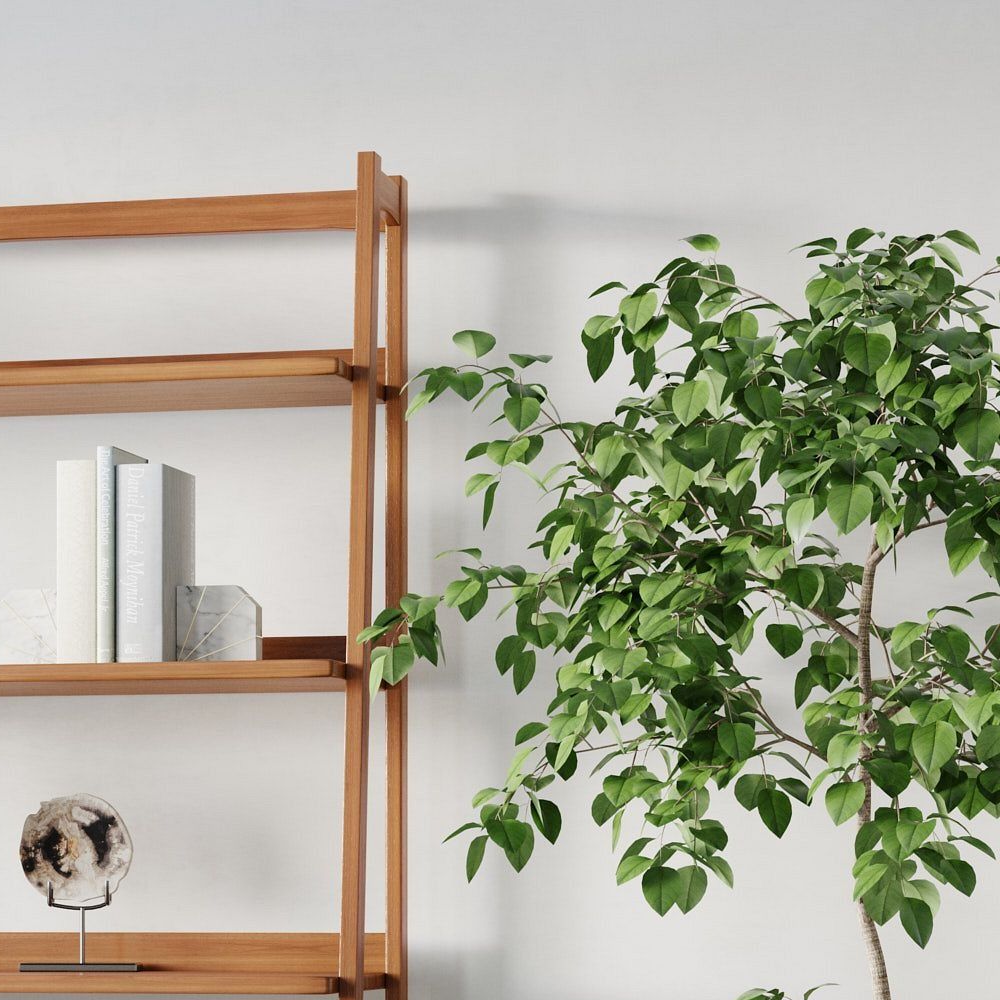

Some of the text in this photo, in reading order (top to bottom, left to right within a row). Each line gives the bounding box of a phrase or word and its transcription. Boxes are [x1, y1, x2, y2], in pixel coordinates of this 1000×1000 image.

[100, 466, 111, 481] Art
[100, 482, 111, 491] of
[127, 466, 145, 507] Daniel
[100, 493, 111, 545] Celebration
[126, 511, 145, 556] Patrick
[120, 560, 145, 624] Moynihan
